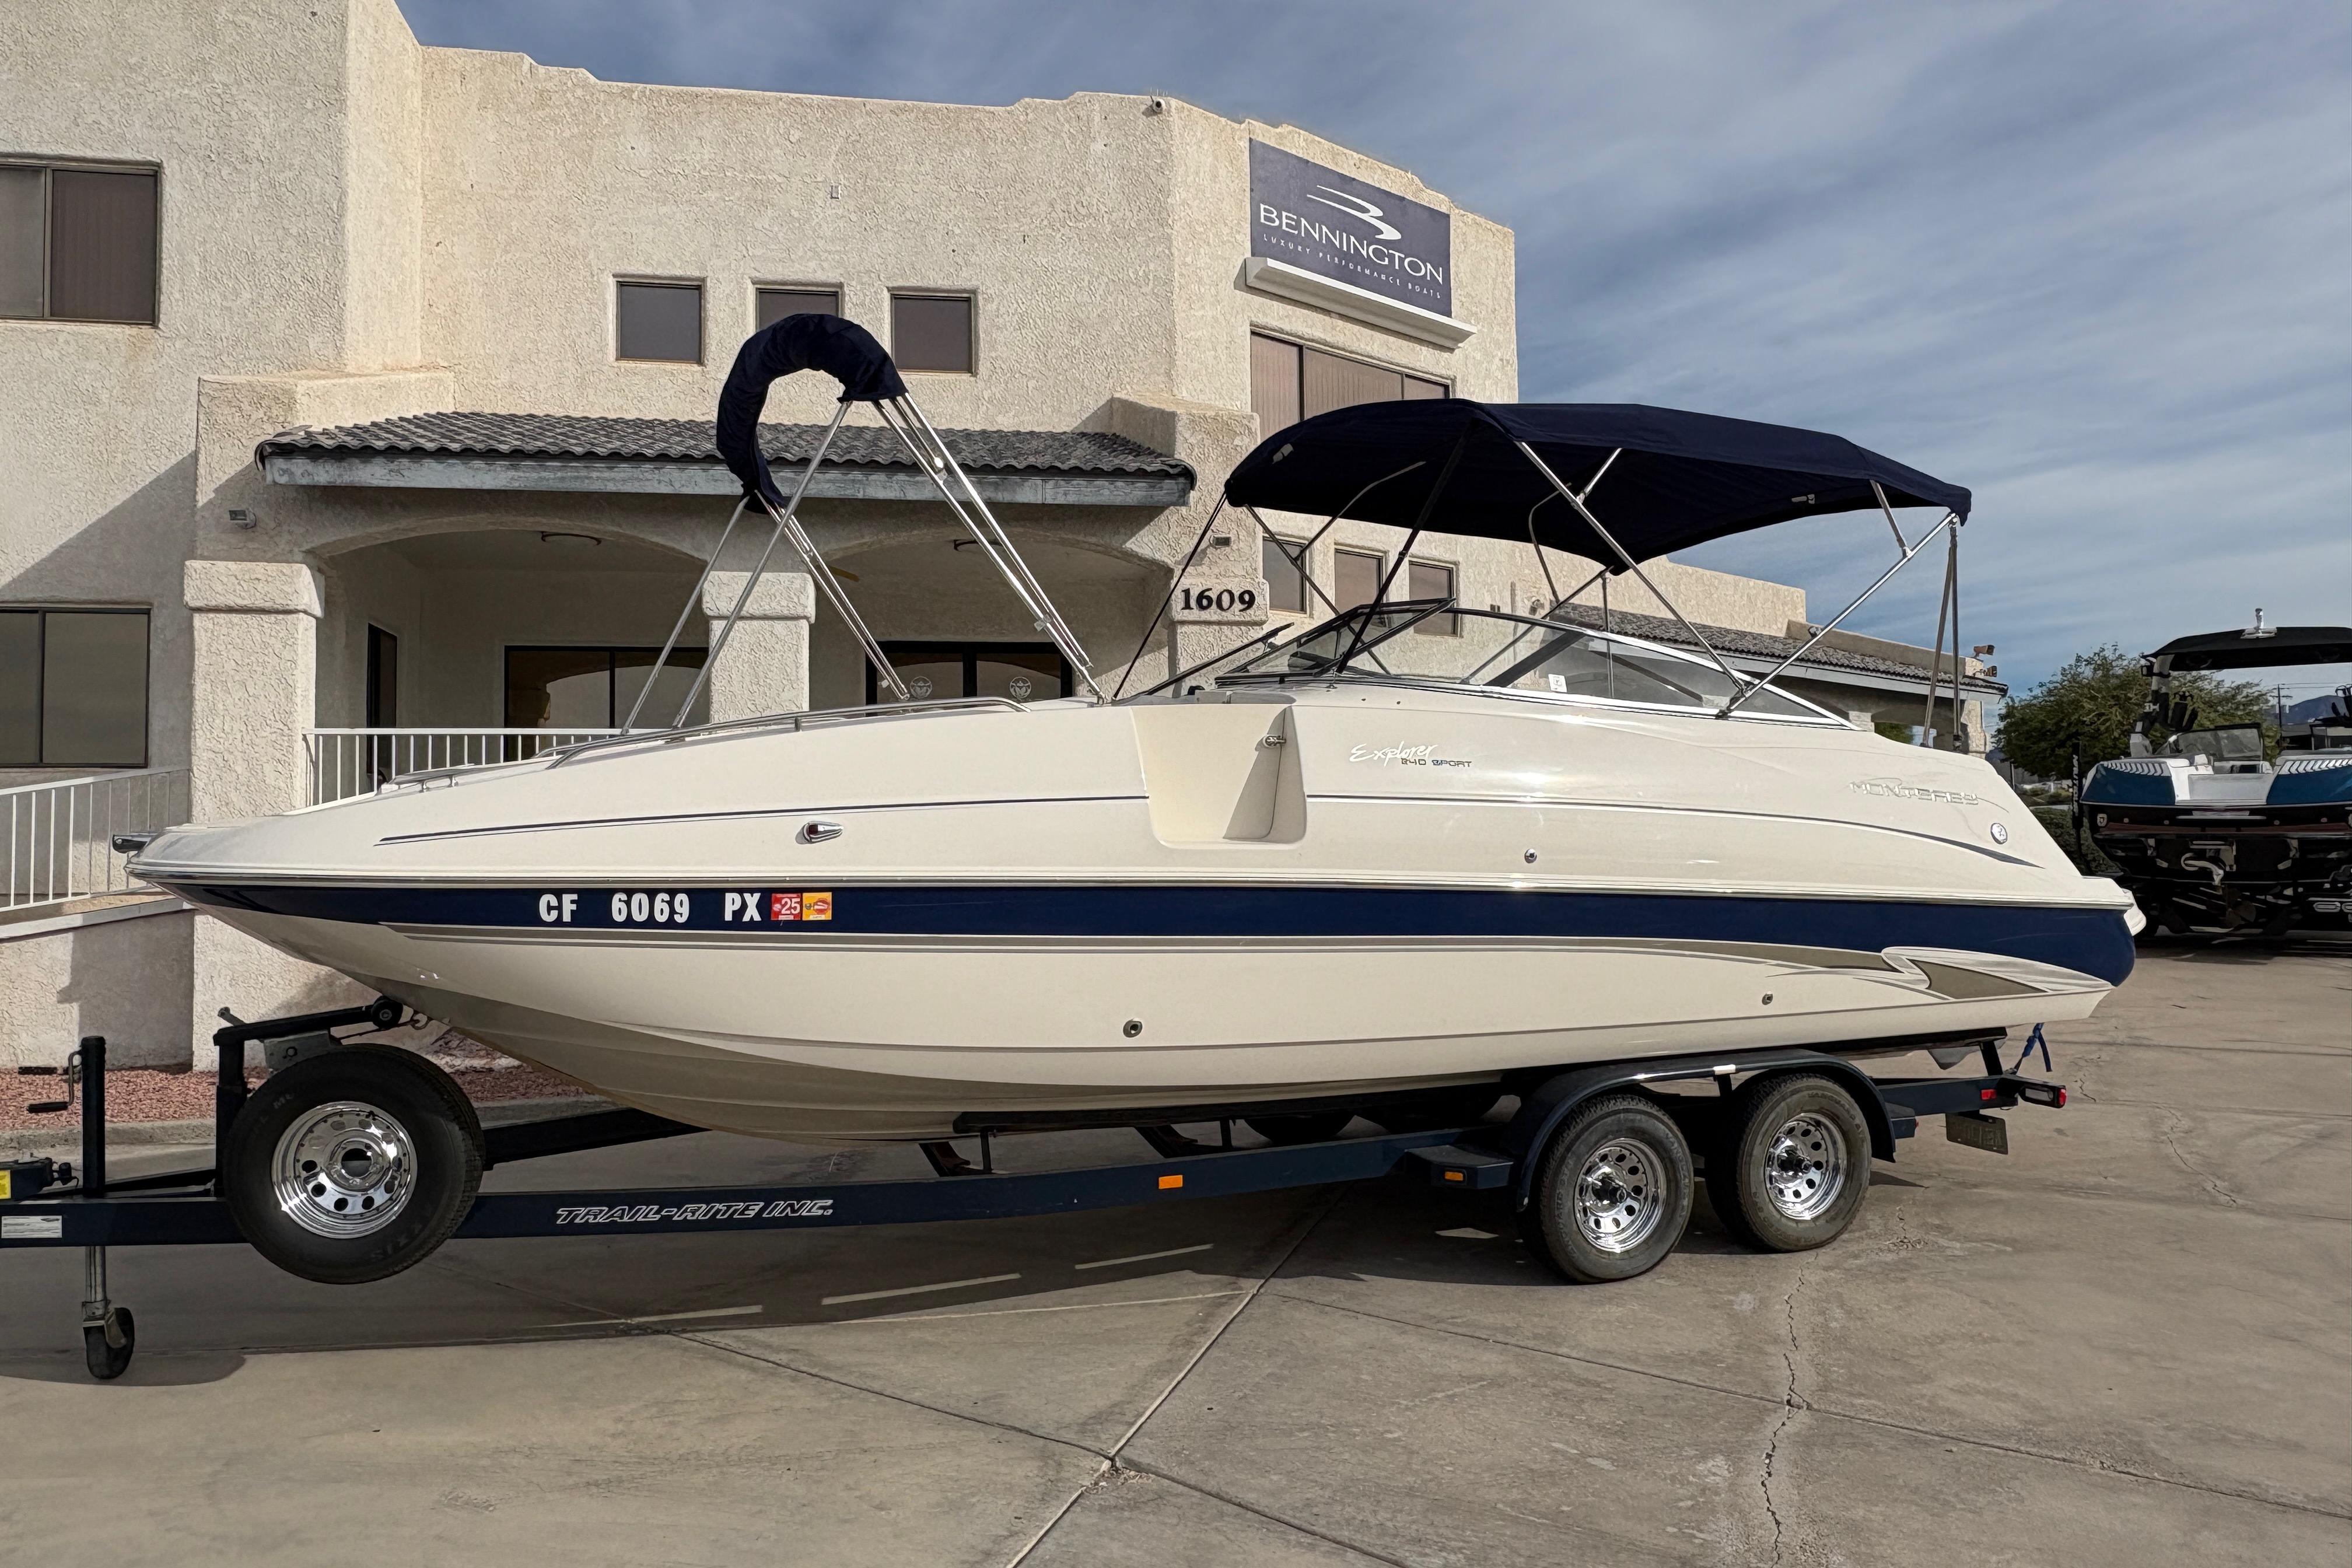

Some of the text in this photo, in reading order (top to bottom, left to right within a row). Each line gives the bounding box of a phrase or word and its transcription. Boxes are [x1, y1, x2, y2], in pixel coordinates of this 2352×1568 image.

[1259, 203, 1443, 285] BENNINGTON
[1264, 233, 1310, 254] LUXURY
[1181, 587, 1256, 612] 1609
[1349, 740, 1439, 767] Explorer
[1432, 759, 1473, 768] SPORT
[538, 892, 761, 923] CF 6069 PX
[781, 897, 800, 915] 25
[555, 1199, 834, 1224] TRAIL-RITE INC.
